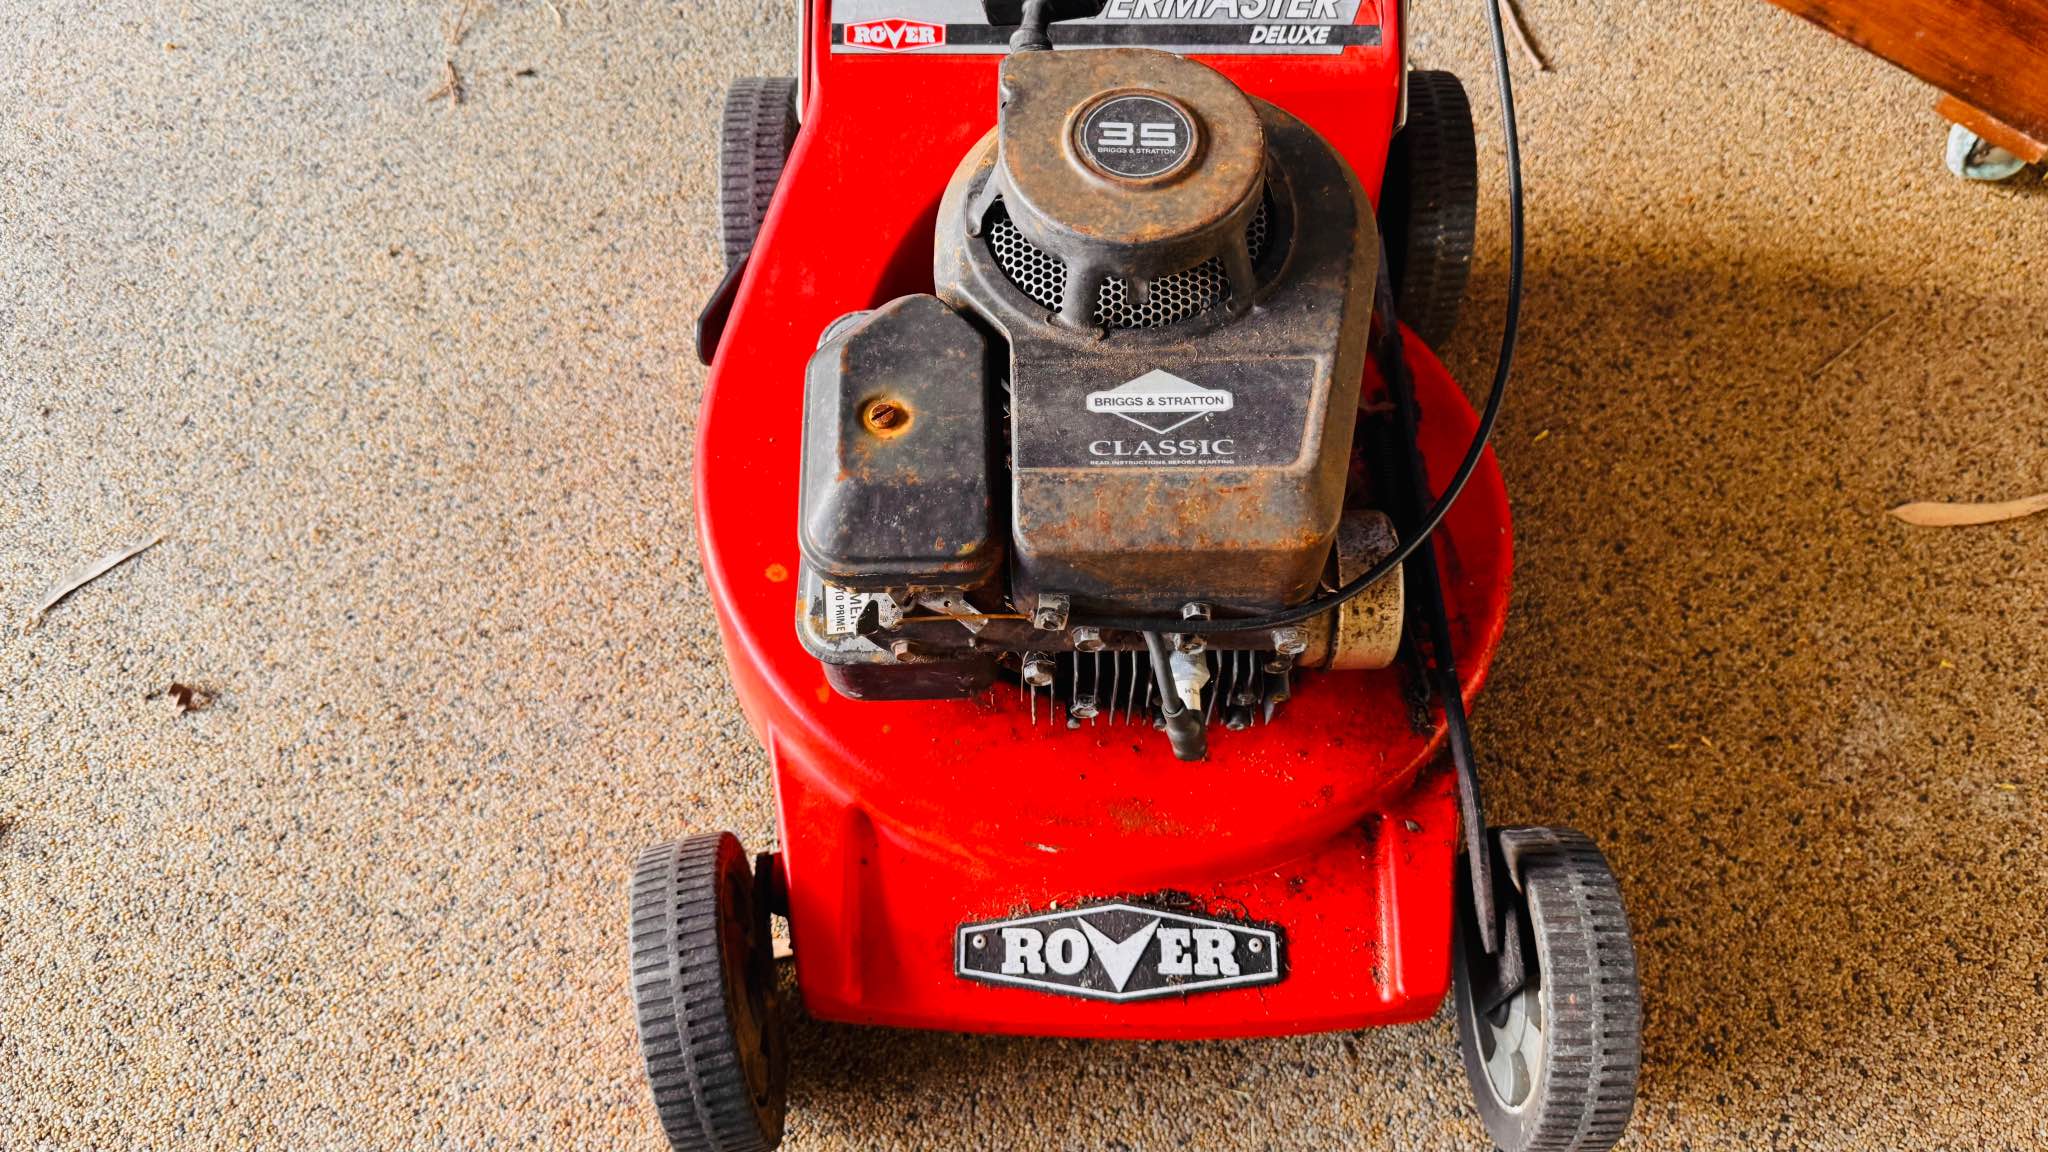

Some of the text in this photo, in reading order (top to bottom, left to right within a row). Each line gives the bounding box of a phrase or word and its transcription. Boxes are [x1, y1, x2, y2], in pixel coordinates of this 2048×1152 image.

[854, 22, 936, 49] ROVER
[1249, 25, 1331, 44] DELUXE
[1098, 121, 1176, 146] 35
[1094, 396, 1224, 406] BRIGGS & STRATTON
[1089, 439, 1235, 456] CLASSIC
[835, 604, 846, 632] PRIME
[1001, 917, 1240, 993] ROVER
